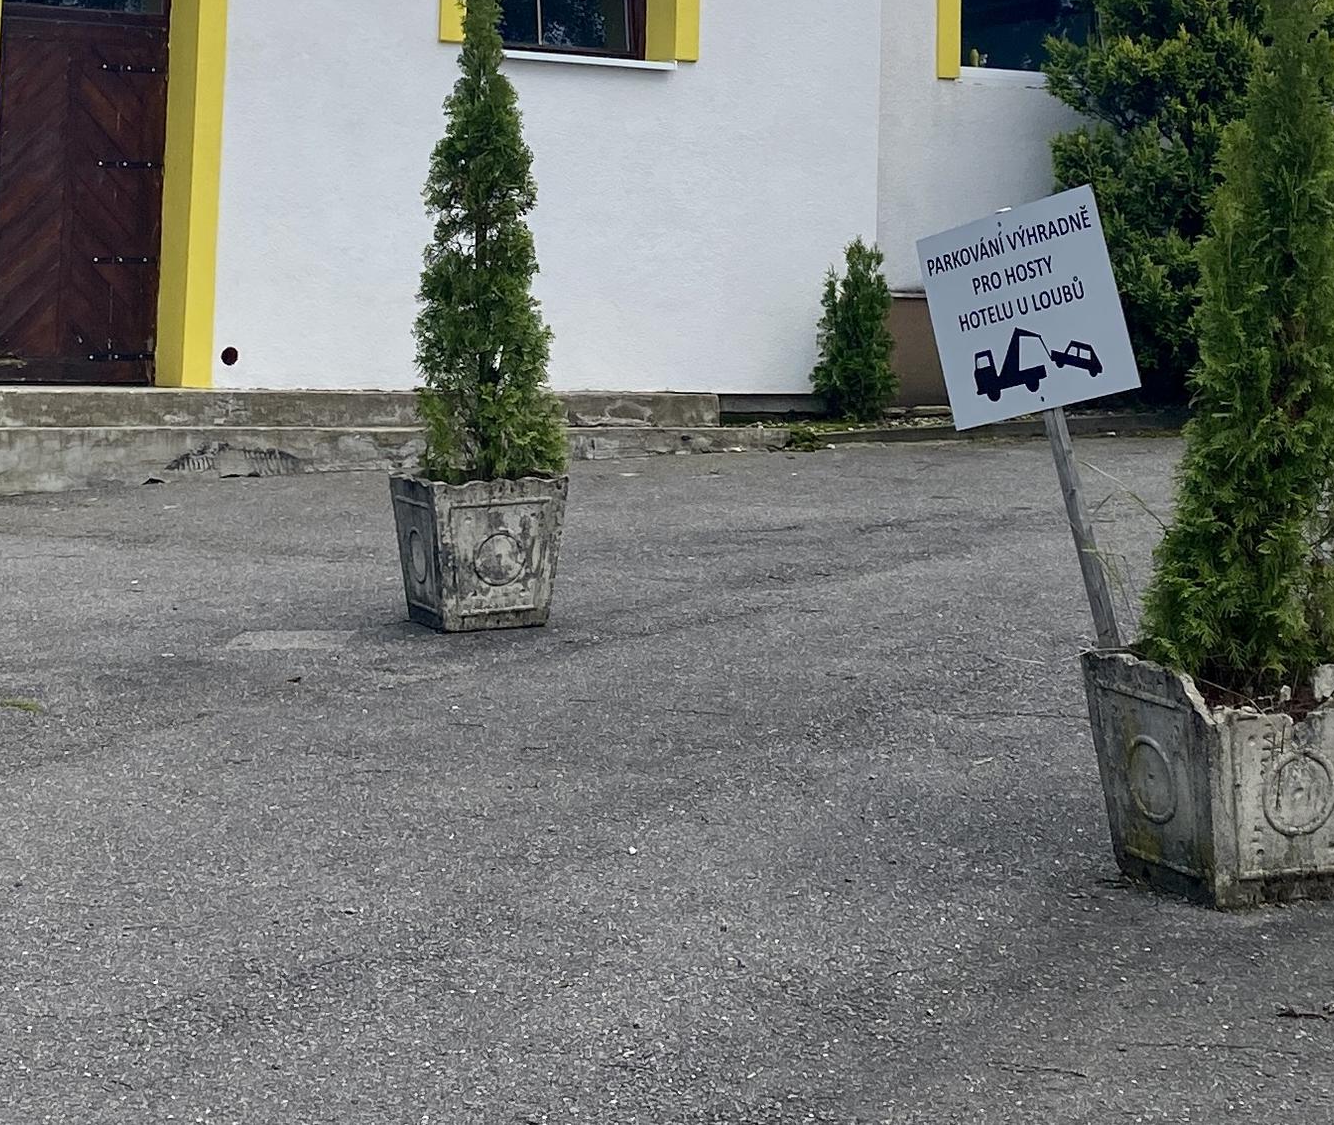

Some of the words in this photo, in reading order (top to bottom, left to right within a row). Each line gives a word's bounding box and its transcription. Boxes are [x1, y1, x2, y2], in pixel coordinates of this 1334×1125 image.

[926, 230, 1005, 277] PARKOVÁNÍ
[1005, 204, 1092, 251] VÝHRADNĚ
[958, 300, 1014, 332] HOTELU
[1016, 296, 1029, 316] U
[1031, 275, 1085, 312] LOUBŮ
[971, 271, 1002, 296] PRO
[1004, 255, 1053, 286] HOSTY
